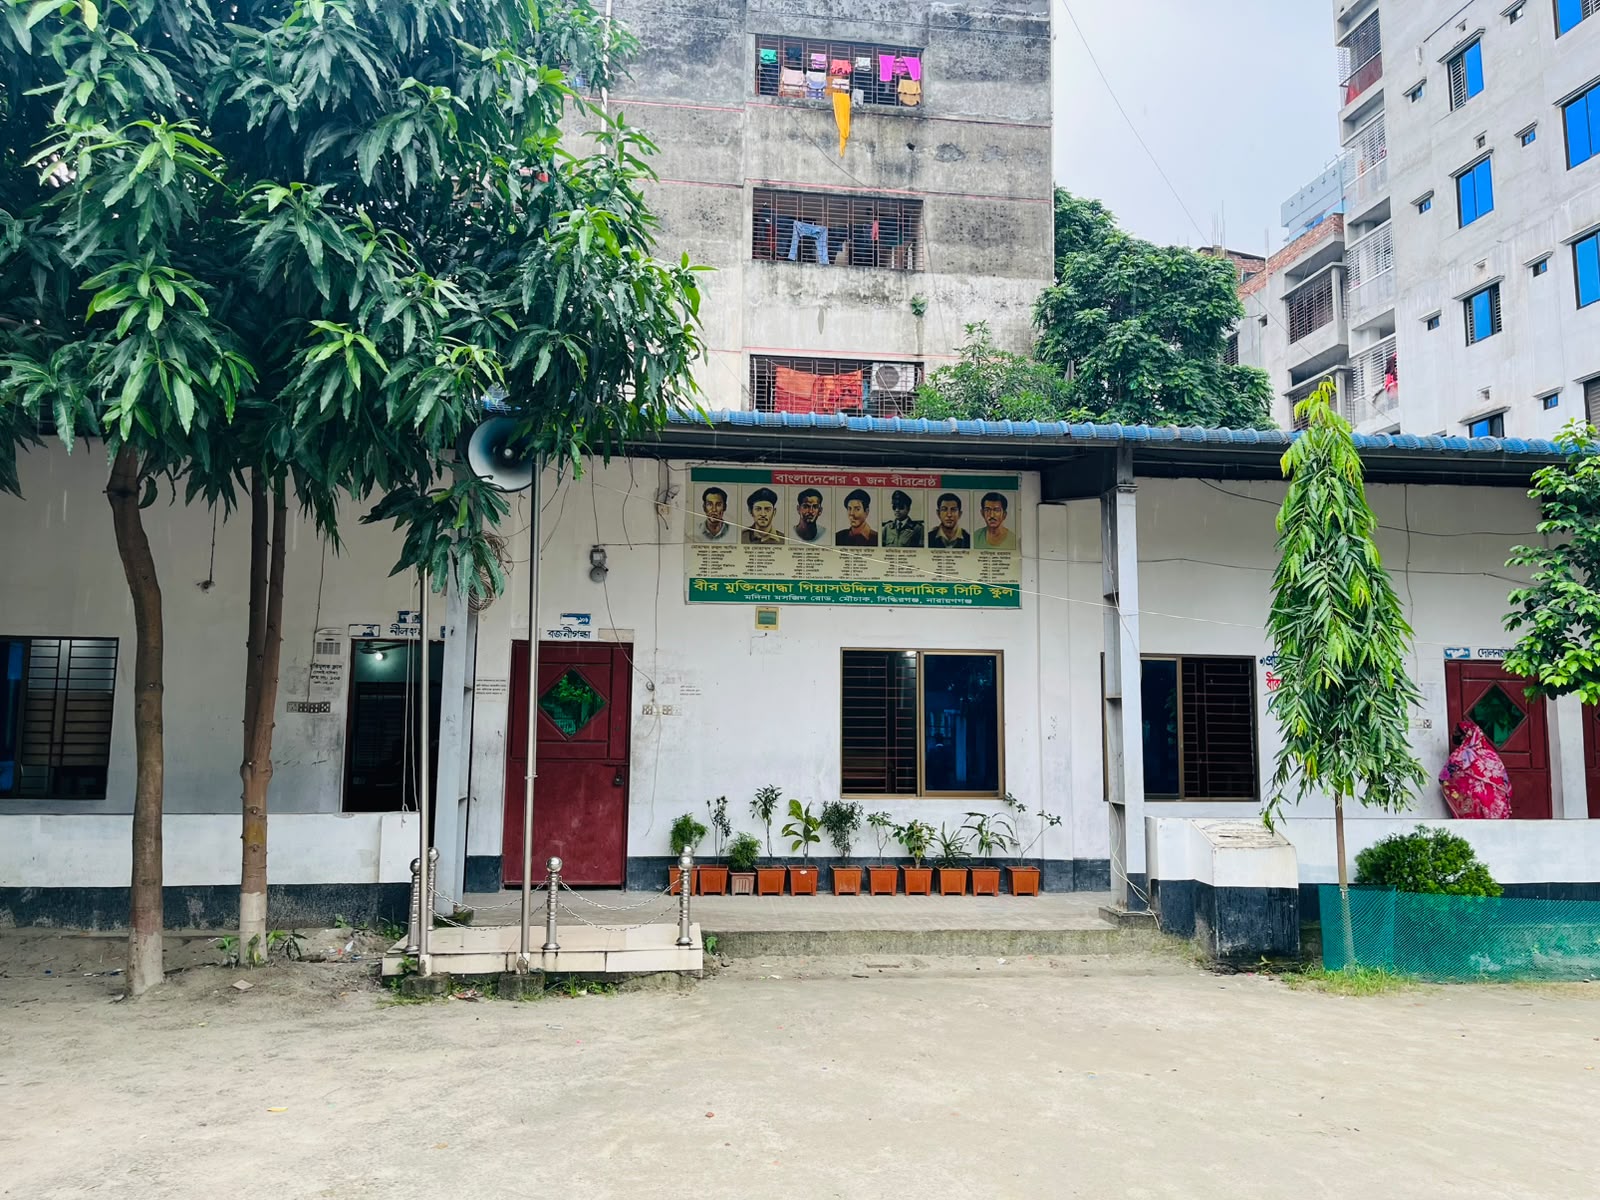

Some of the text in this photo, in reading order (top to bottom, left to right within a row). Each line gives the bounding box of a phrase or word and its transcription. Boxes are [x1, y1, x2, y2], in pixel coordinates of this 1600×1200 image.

[775, 473, 937, 487] বাংলাদেশের ৭ জন বীরশ্রেষ্ঠ
[693, 579, 1013, 599] বীর মুক্তিযোদ্ধা গিয়াসউদ্দিন ইসলামিক সিটি স্কুল
